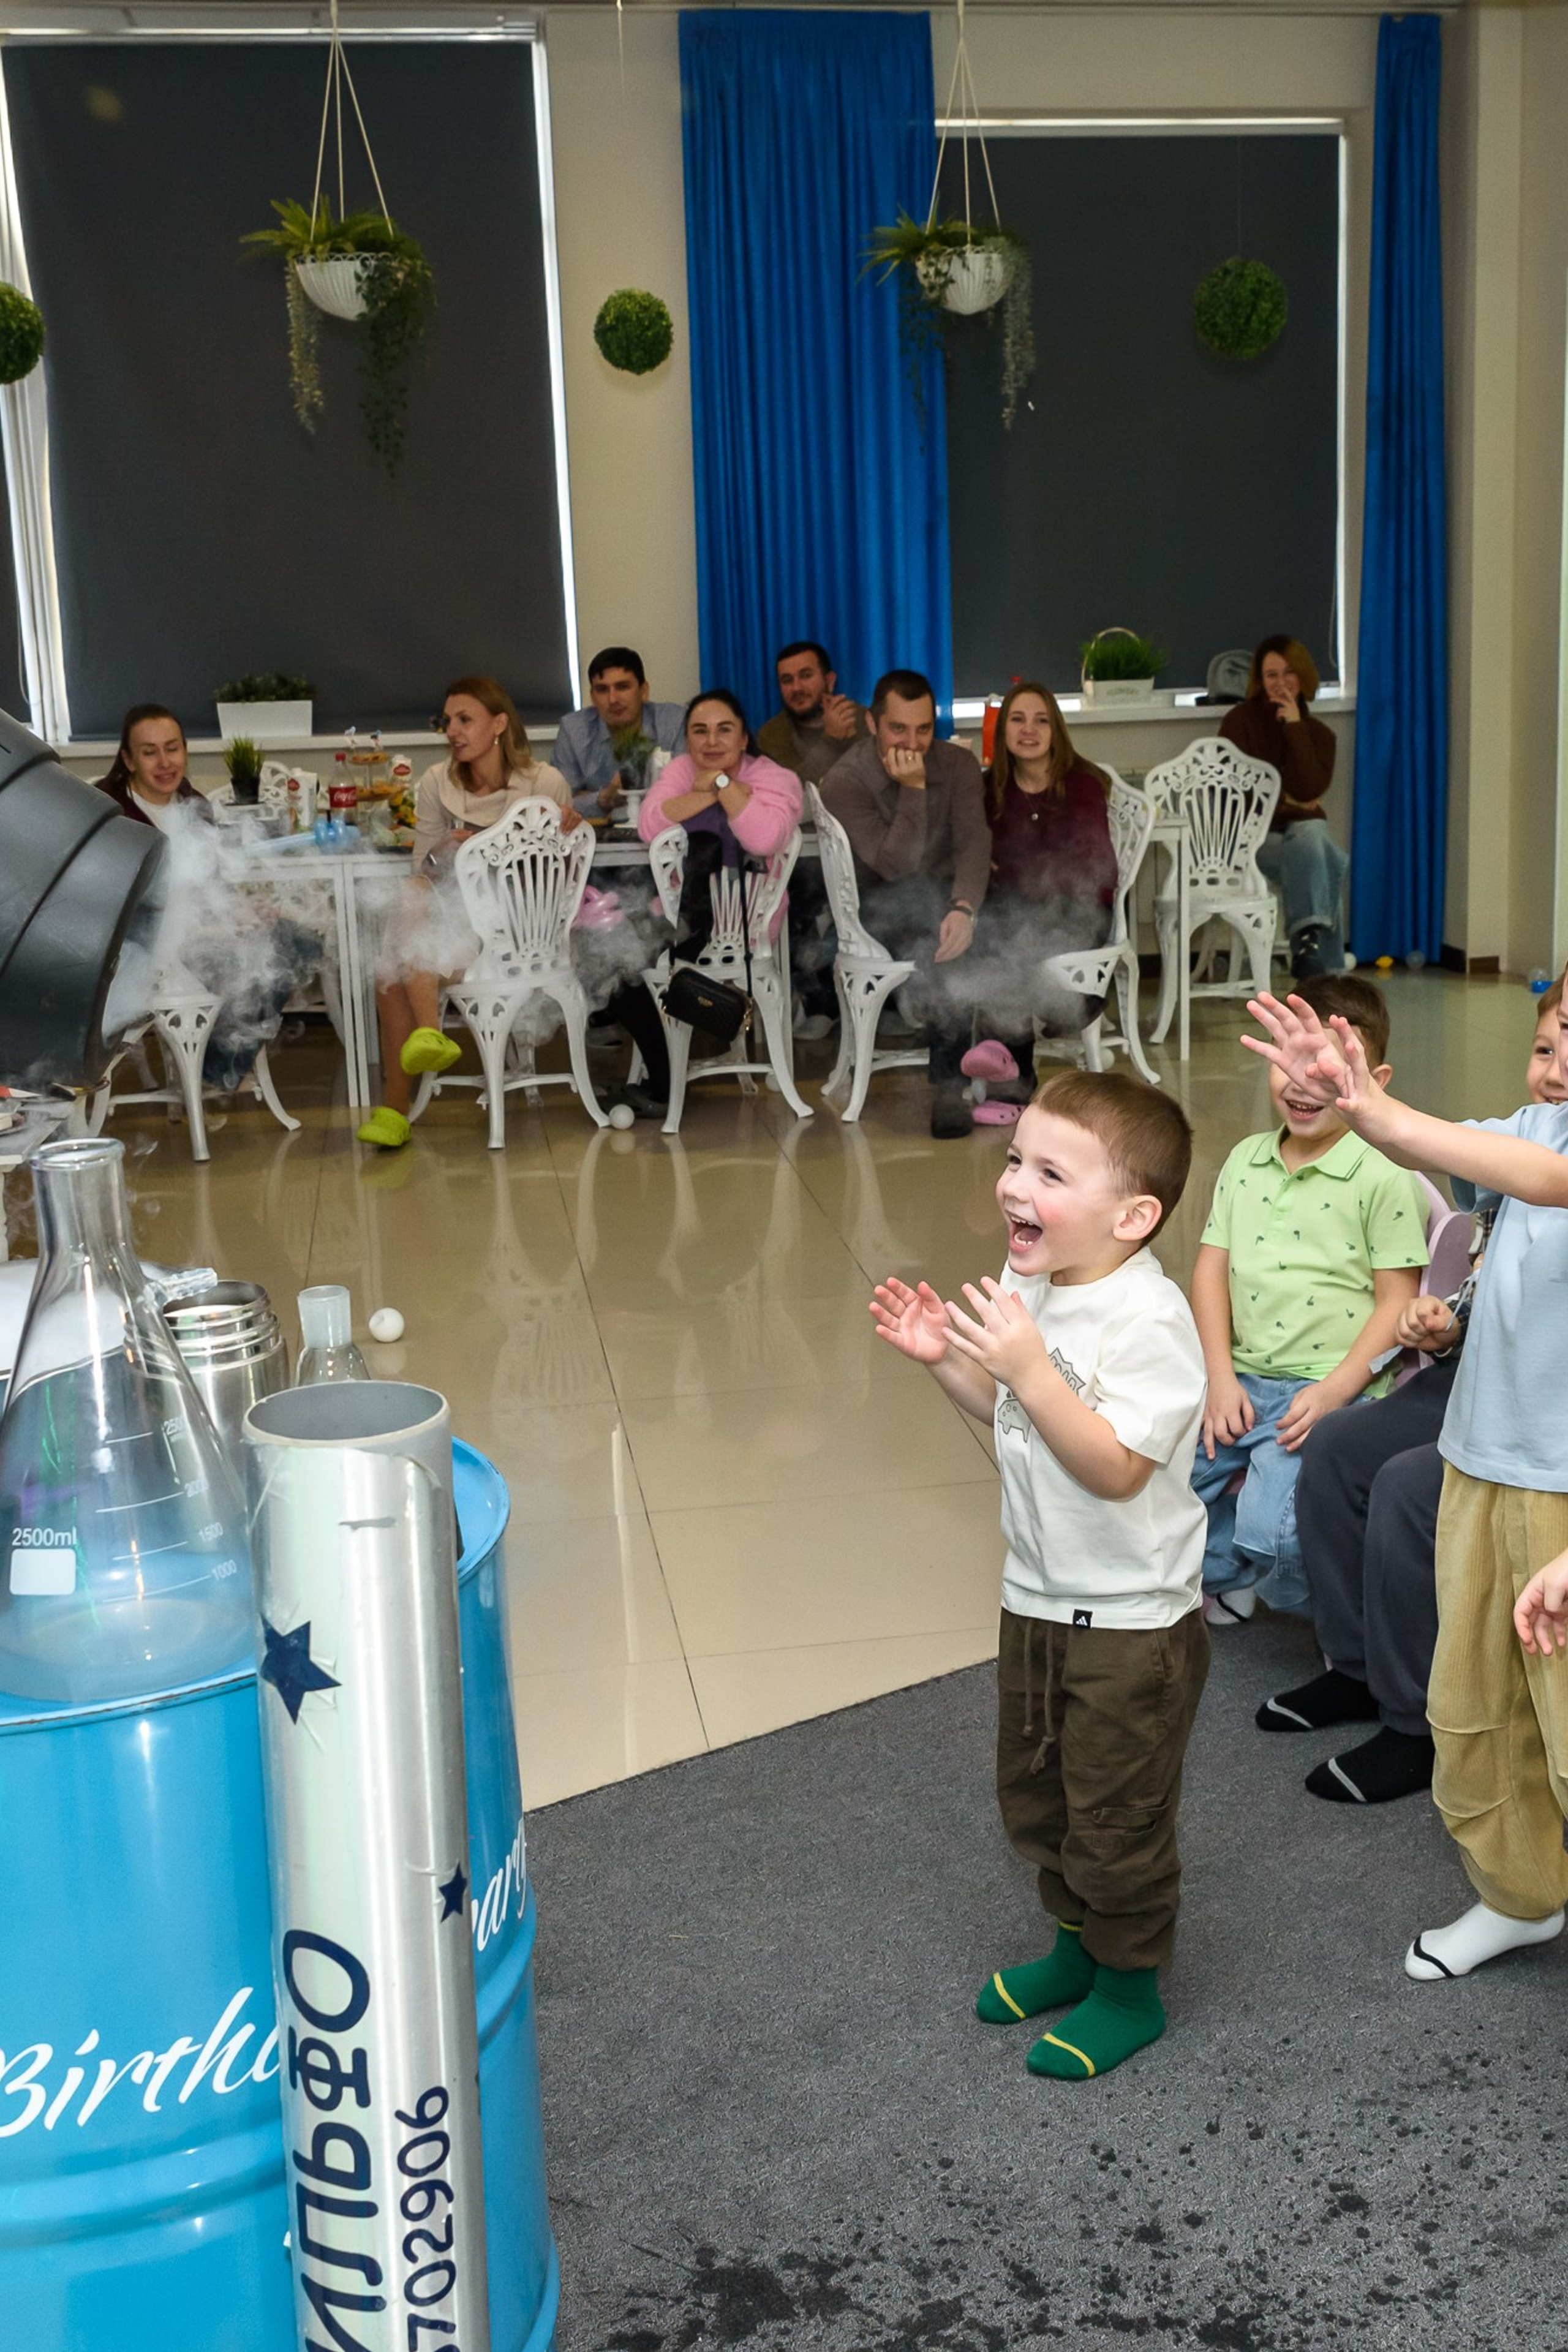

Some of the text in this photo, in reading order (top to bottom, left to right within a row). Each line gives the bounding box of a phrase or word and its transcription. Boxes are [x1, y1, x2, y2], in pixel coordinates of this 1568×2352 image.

[12, 1526, 77, 1547] 2500ml
[198, 1522, 224, 1542] 1500
[212, 1559, 237, 1581] 1000
[395, 2086, 462, 2352] 702906
